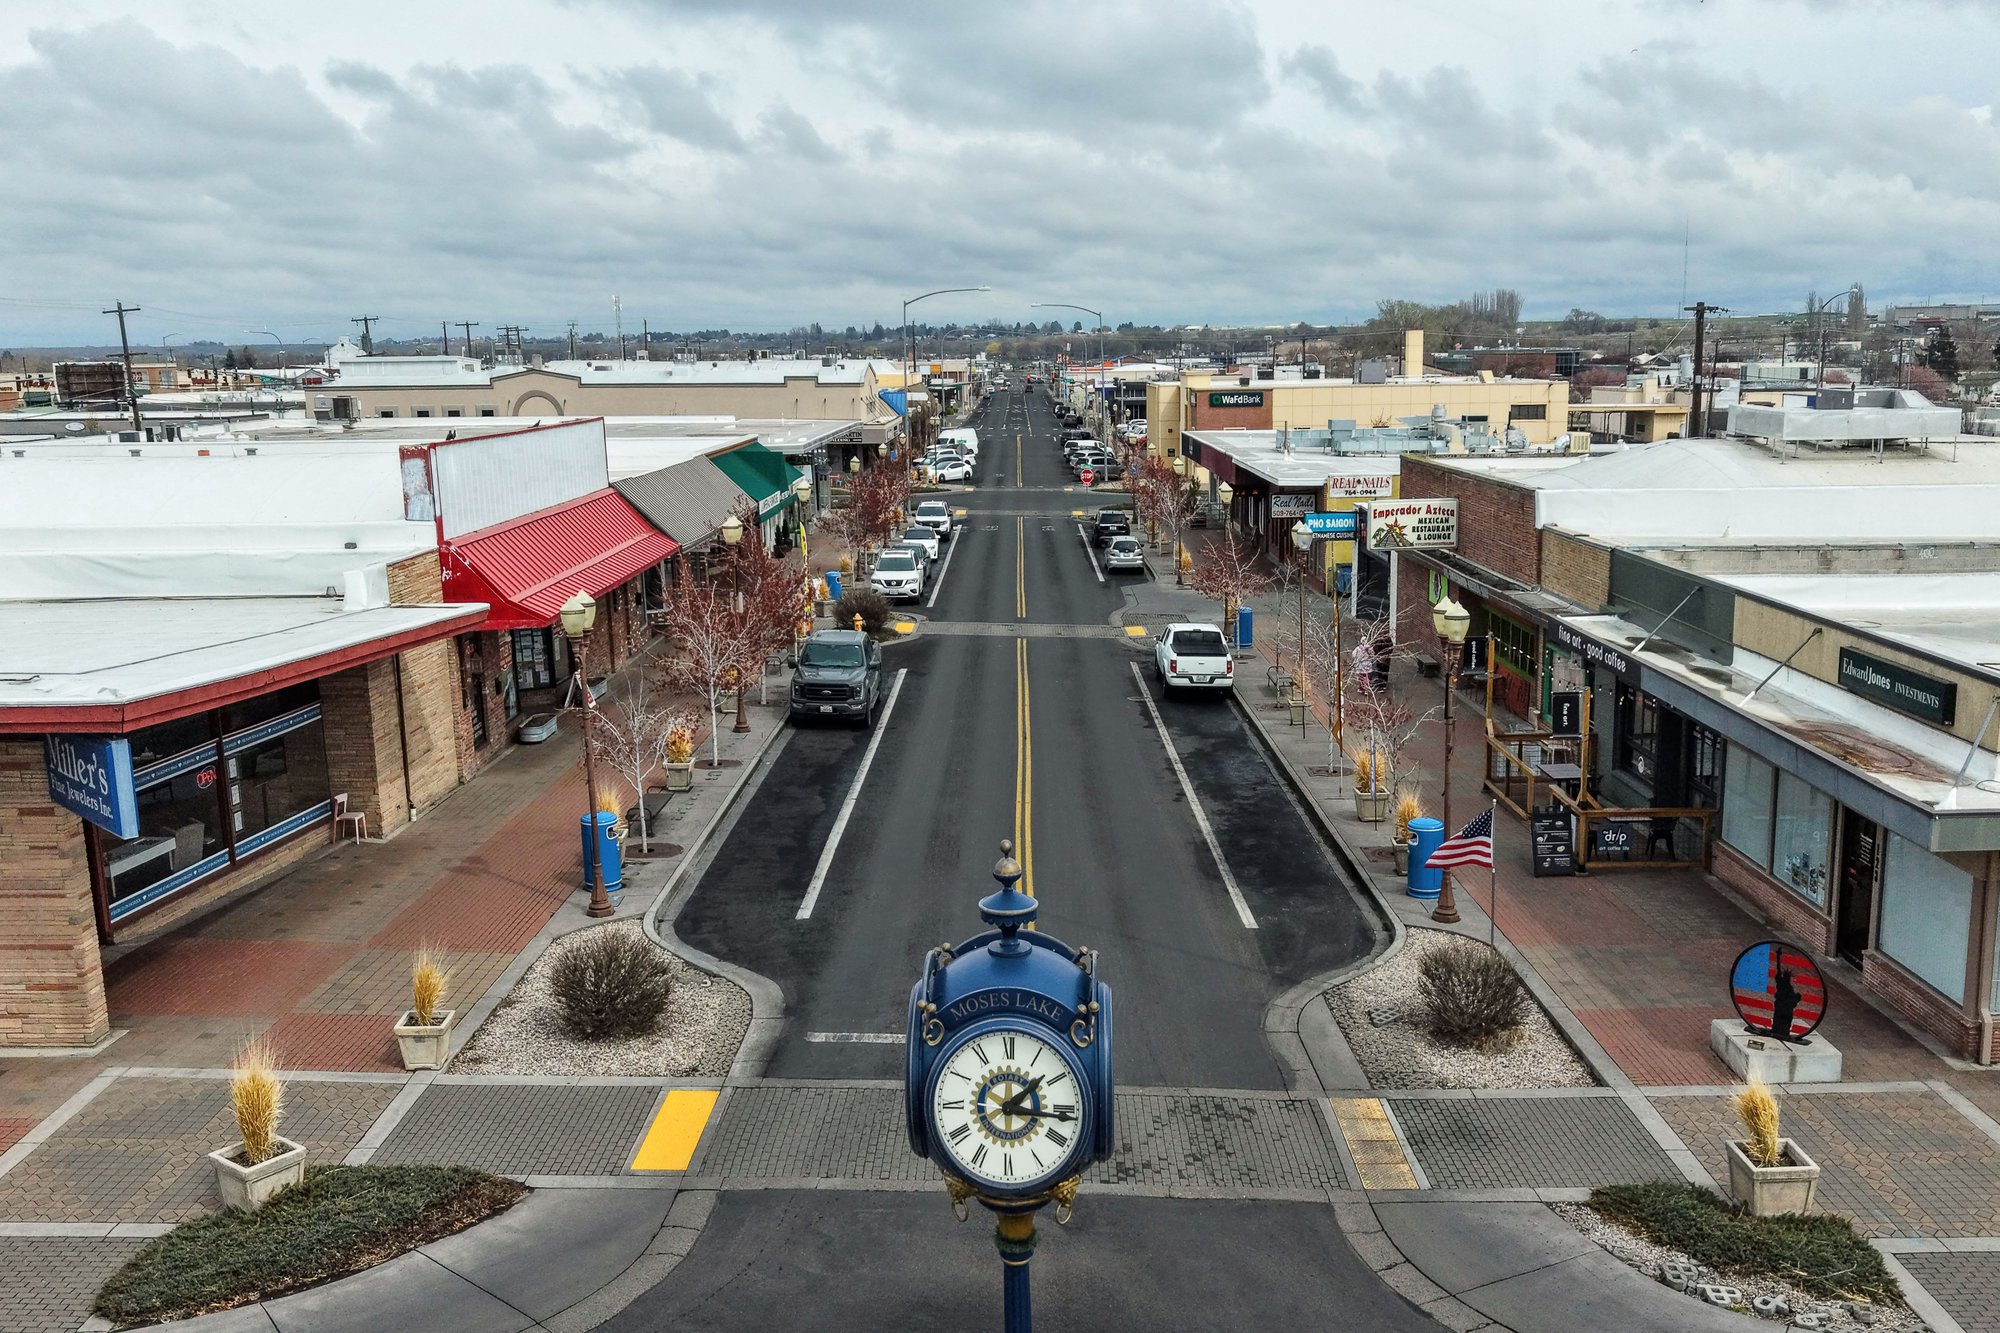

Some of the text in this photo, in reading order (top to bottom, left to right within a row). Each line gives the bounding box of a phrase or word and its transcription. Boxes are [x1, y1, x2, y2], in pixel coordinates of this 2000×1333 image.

[1243, 395, 1261, 404] Bank
[1332, 477, 1391, 490] REAL NAILS
[1272, 496, 1314, 508] Real Nails
[1373, 504, 1455, 519] Emperador Azteca
[1308, 519, 1355, 529] PHO SAIGON
[1417, 517, 1450, 525] MEXICAN
[1411, 525, 1455, 533] RESTAURANT
[1416, 533, 1451, 541] & LOUNGE
[1558, 625, 1627, 673] fine art good coffee
[1894, 681, 1940, 709] INVESTMENTS
[1562, 702, 1570, 715] fine
[46, 733, 109, 796] Miller's
[196, 768, 217, 786] OPEN
[50, 773, 114, 820] Fine Jewelers Inc.
[950, 992, 1064, 1022] MOSES LAKE
[991, 1073, 1026, 1084] ROTARY
[981, 1119, 1038, 1140] INTERNATIONAL
